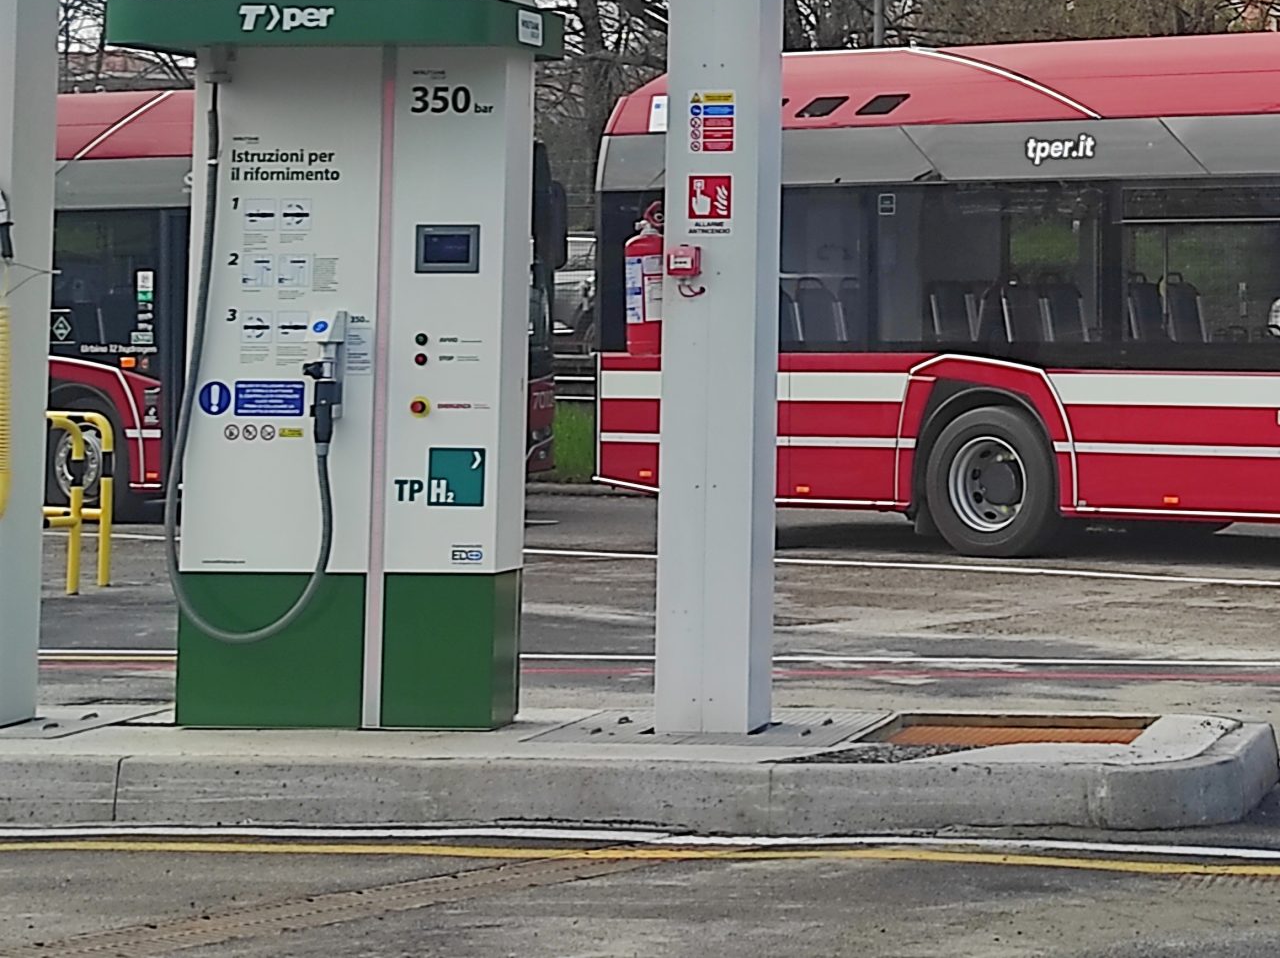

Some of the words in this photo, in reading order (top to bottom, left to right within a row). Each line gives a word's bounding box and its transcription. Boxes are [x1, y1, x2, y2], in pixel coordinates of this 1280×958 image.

[411, 86, 471, 113] 350
[474, 103, 494, 113] bar
[1027, 134, 1095, 165] tper.it
[232, 149, 304, 163] Istruzioni
[308, 152, 335, 166] per
[231, 167, 240, 181] il
[243, 167, 340, 181] rifornimento
[231, 197, 240, 210] 1
[228, 253, 239, 266] 2
[226, 308, 238, 322] 3
[394, 479, 424, 502] TP
